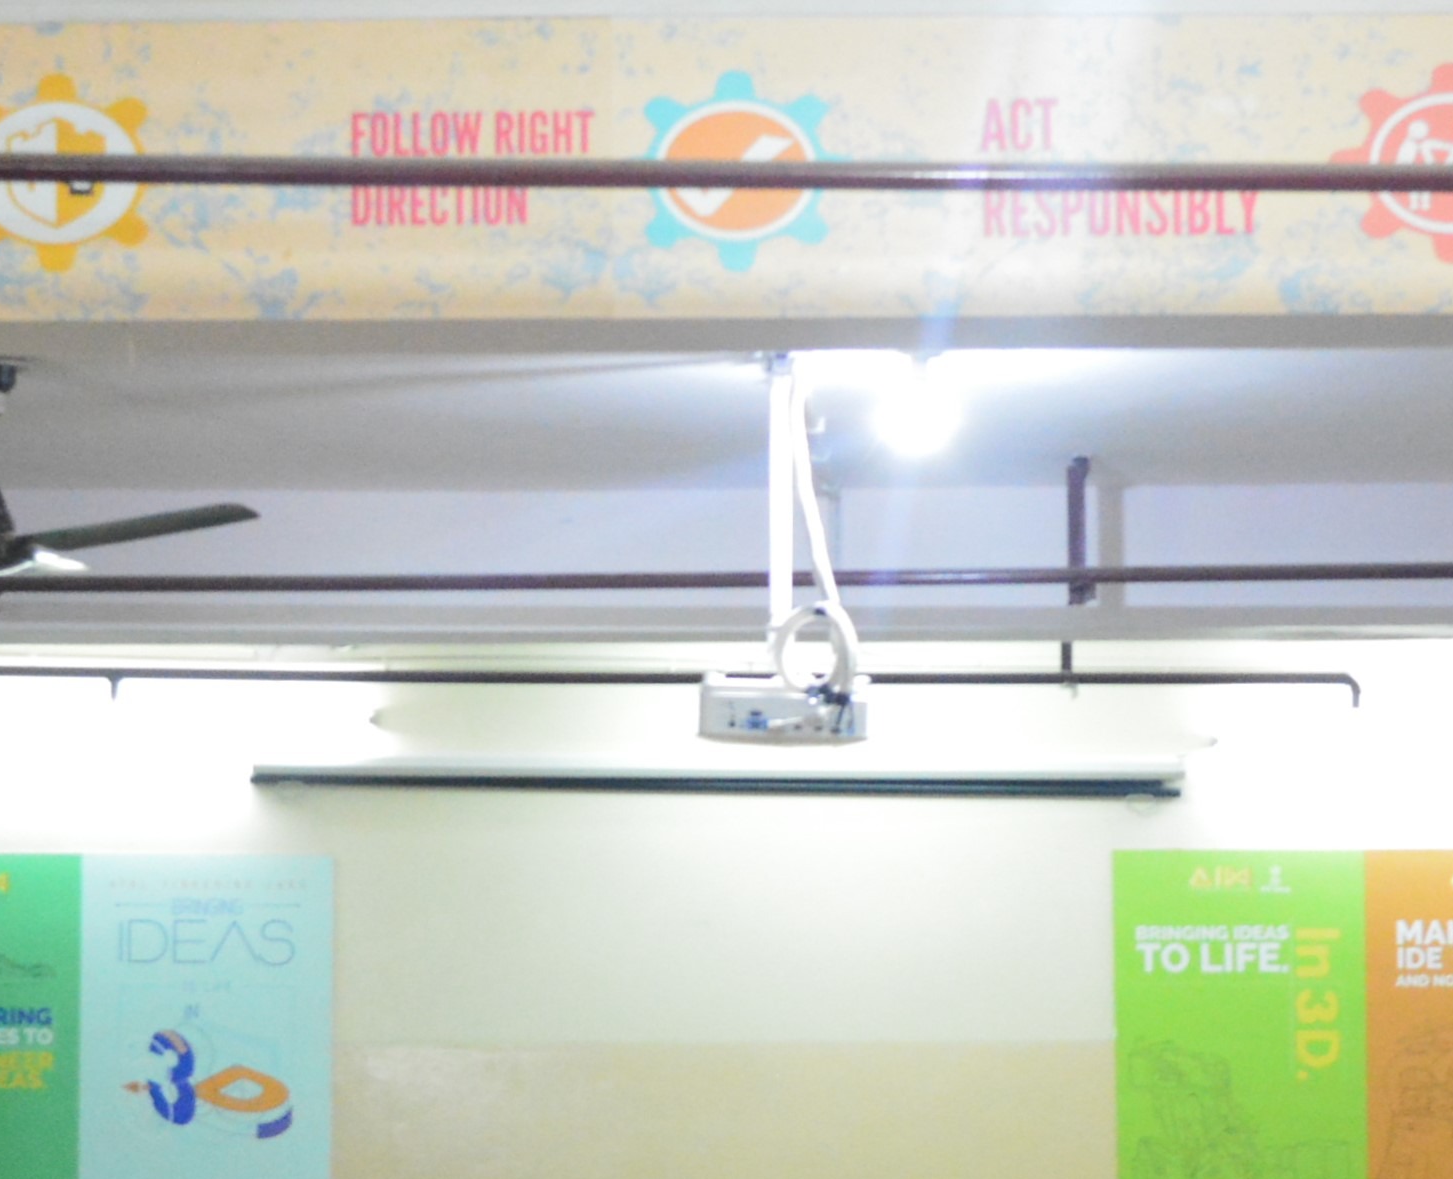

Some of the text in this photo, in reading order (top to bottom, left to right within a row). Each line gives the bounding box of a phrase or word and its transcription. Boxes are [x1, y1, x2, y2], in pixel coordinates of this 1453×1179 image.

[351, 110, 595, 156] FOLLOW RIGHT
[980, 96, 1059, 151] ACT
[351, 184, 529, 227] DIRECTION
[982, 188, 1261, 238] RESPONSIBLY
[117, 918, 297, 967] IDEAS
[1135, 924, 1290, 941] BRINGING IDEAS
[1135, 943, 1290, 974] TO LIFE.
[1396, 974, 1431, 989] AND
[23, 1027, 53, 1045] TO
